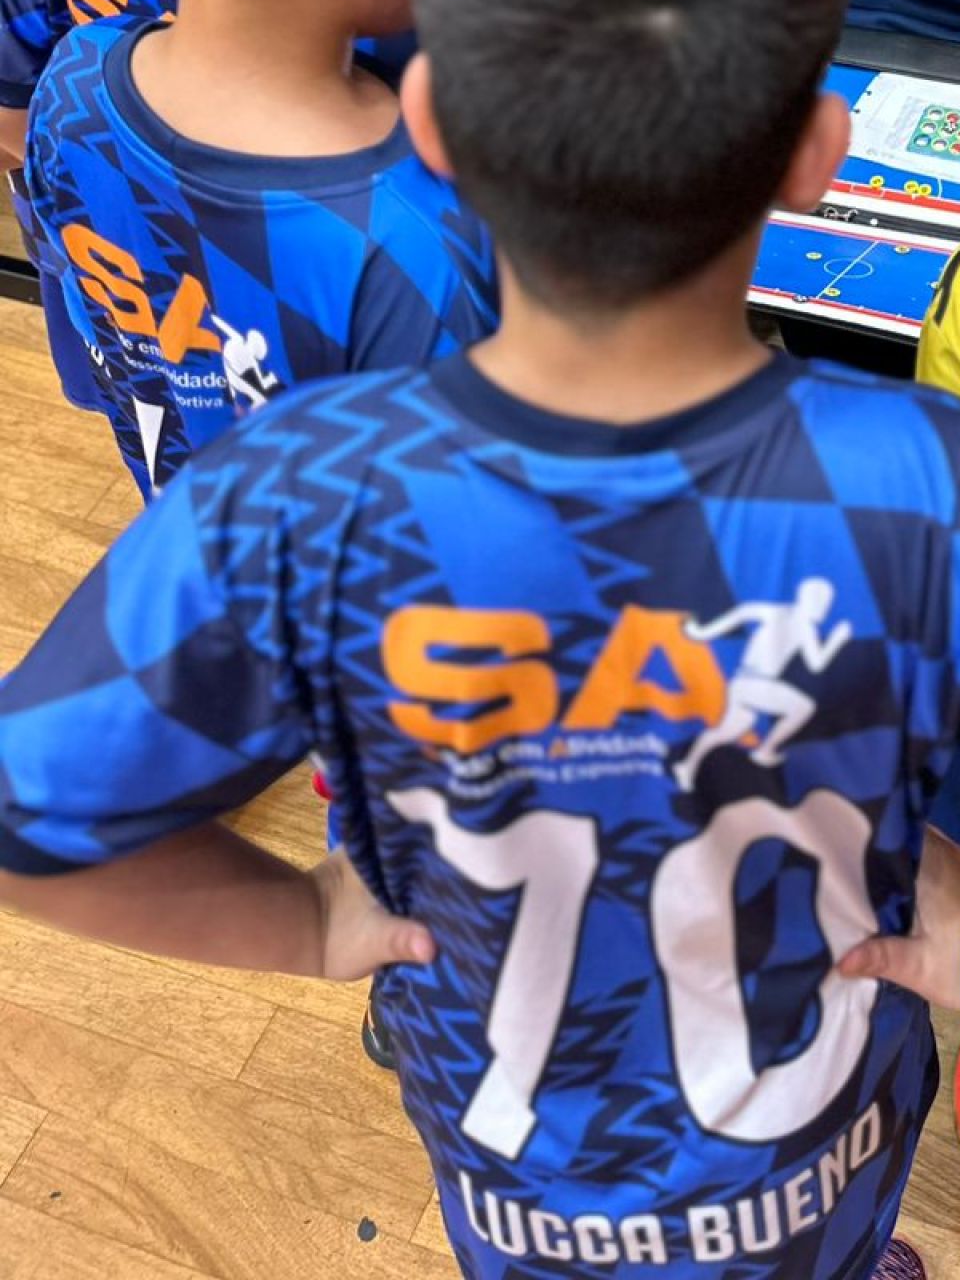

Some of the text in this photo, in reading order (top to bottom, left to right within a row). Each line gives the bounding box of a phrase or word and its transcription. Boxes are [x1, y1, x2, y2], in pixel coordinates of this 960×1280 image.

[382, 602, 757, 754] SA
[459, 1102, 882, 1265] LUCCA BUENO
